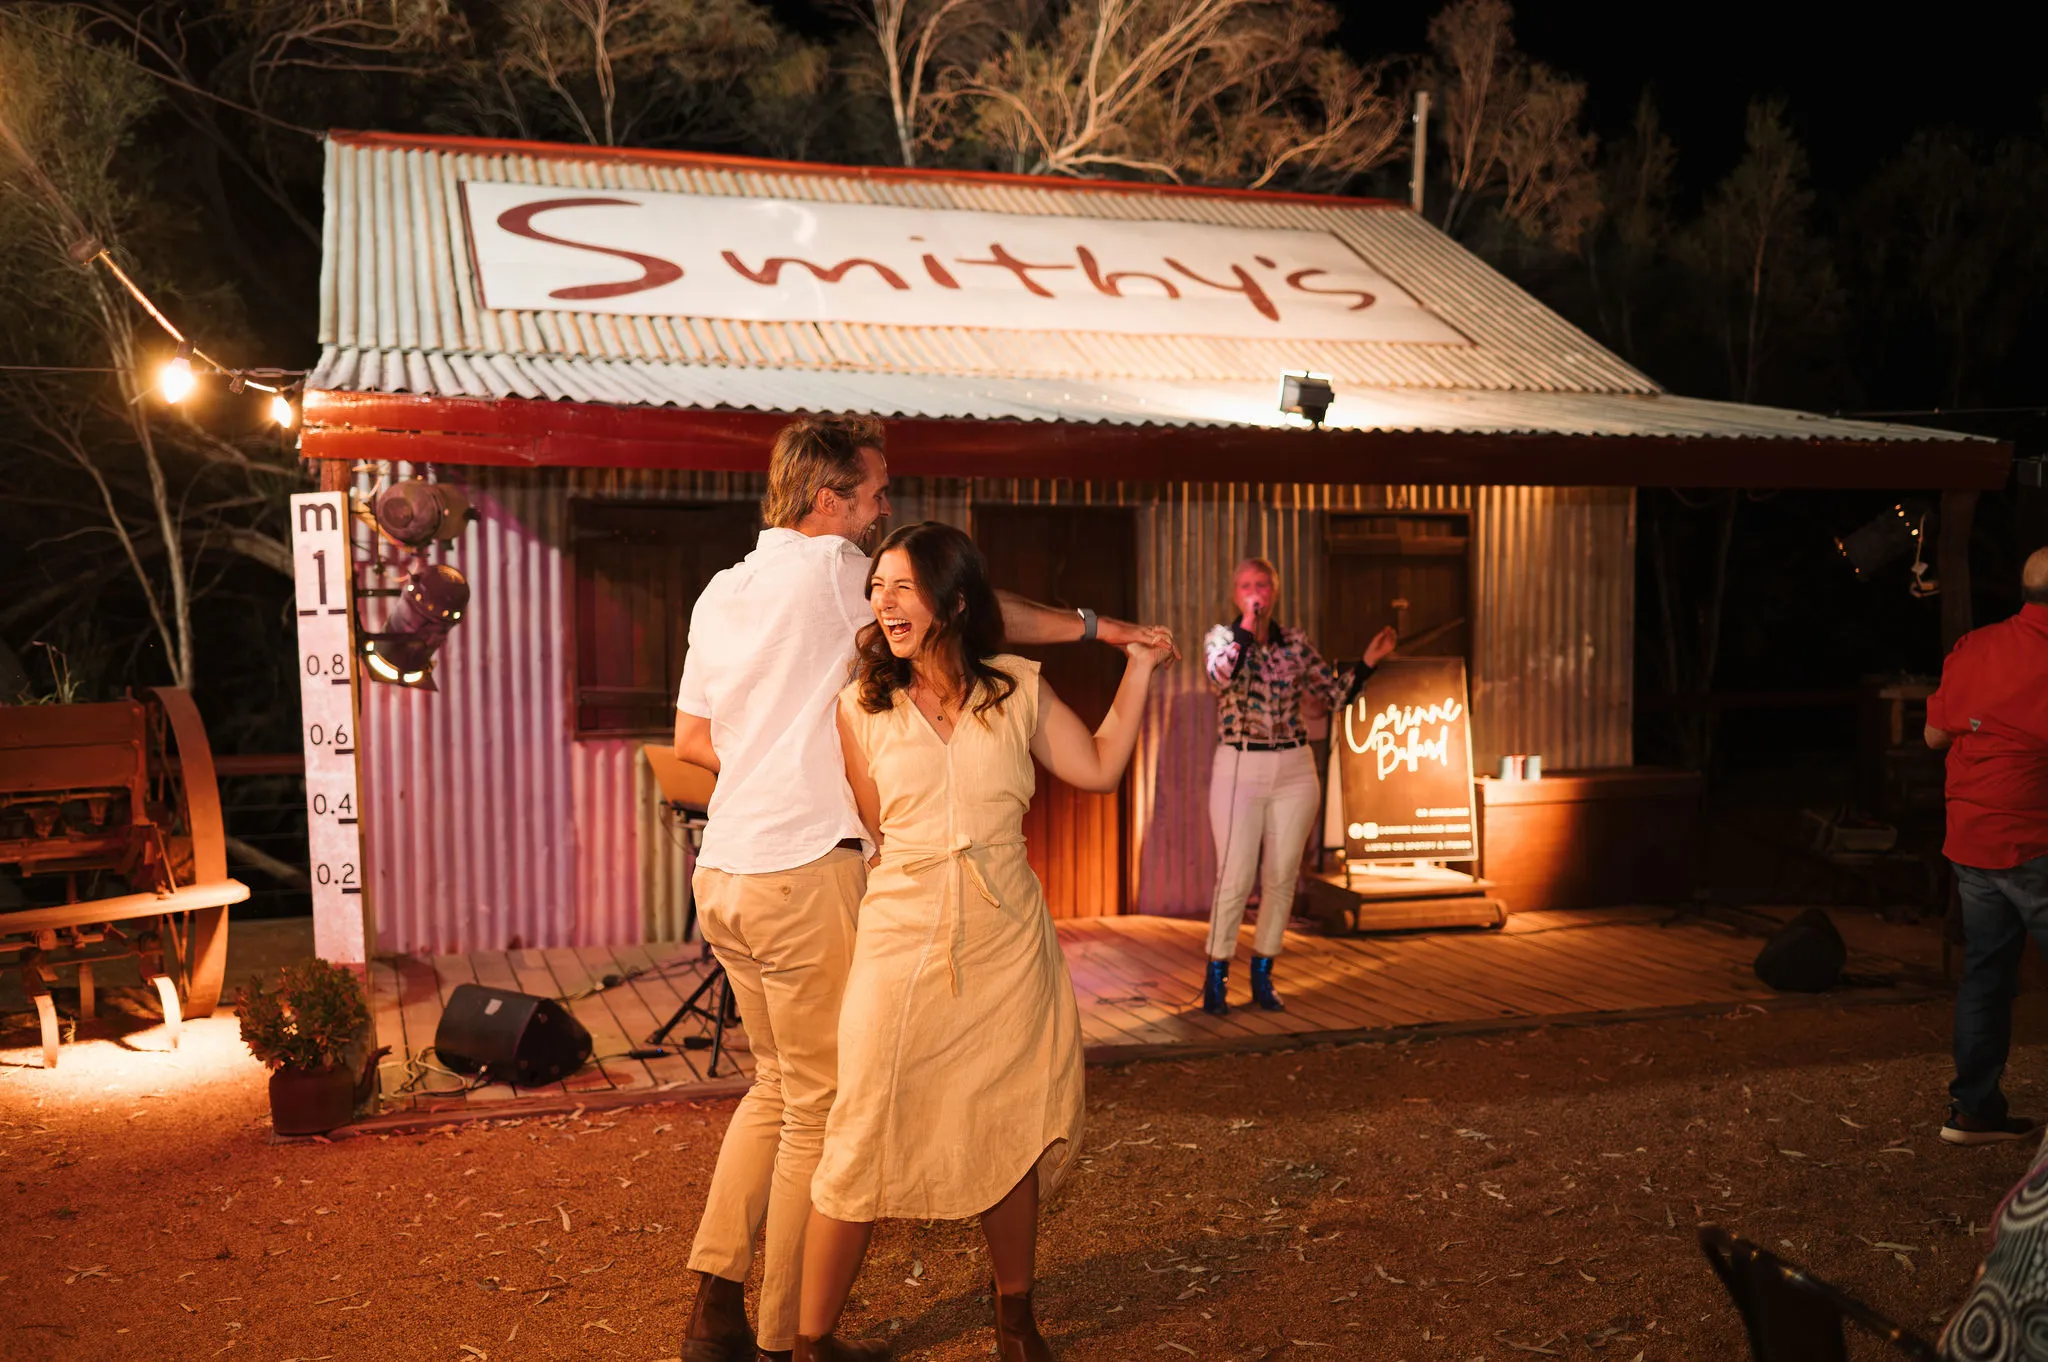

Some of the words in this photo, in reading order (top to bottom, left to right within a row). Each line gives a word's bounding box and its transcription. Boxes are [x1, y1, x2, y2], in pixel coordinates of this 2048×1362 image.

[497, 197, 1377, 322] Smithy's
[299, 502, 338, 532] m
[312, 549, 328, 605] 1
[306, 653, 345, 676] 0.8
[310, 724, 348, 746] 0.6
[313, 793, 352, 815] 0.4
[317, 863, 356, 885] 0.2
